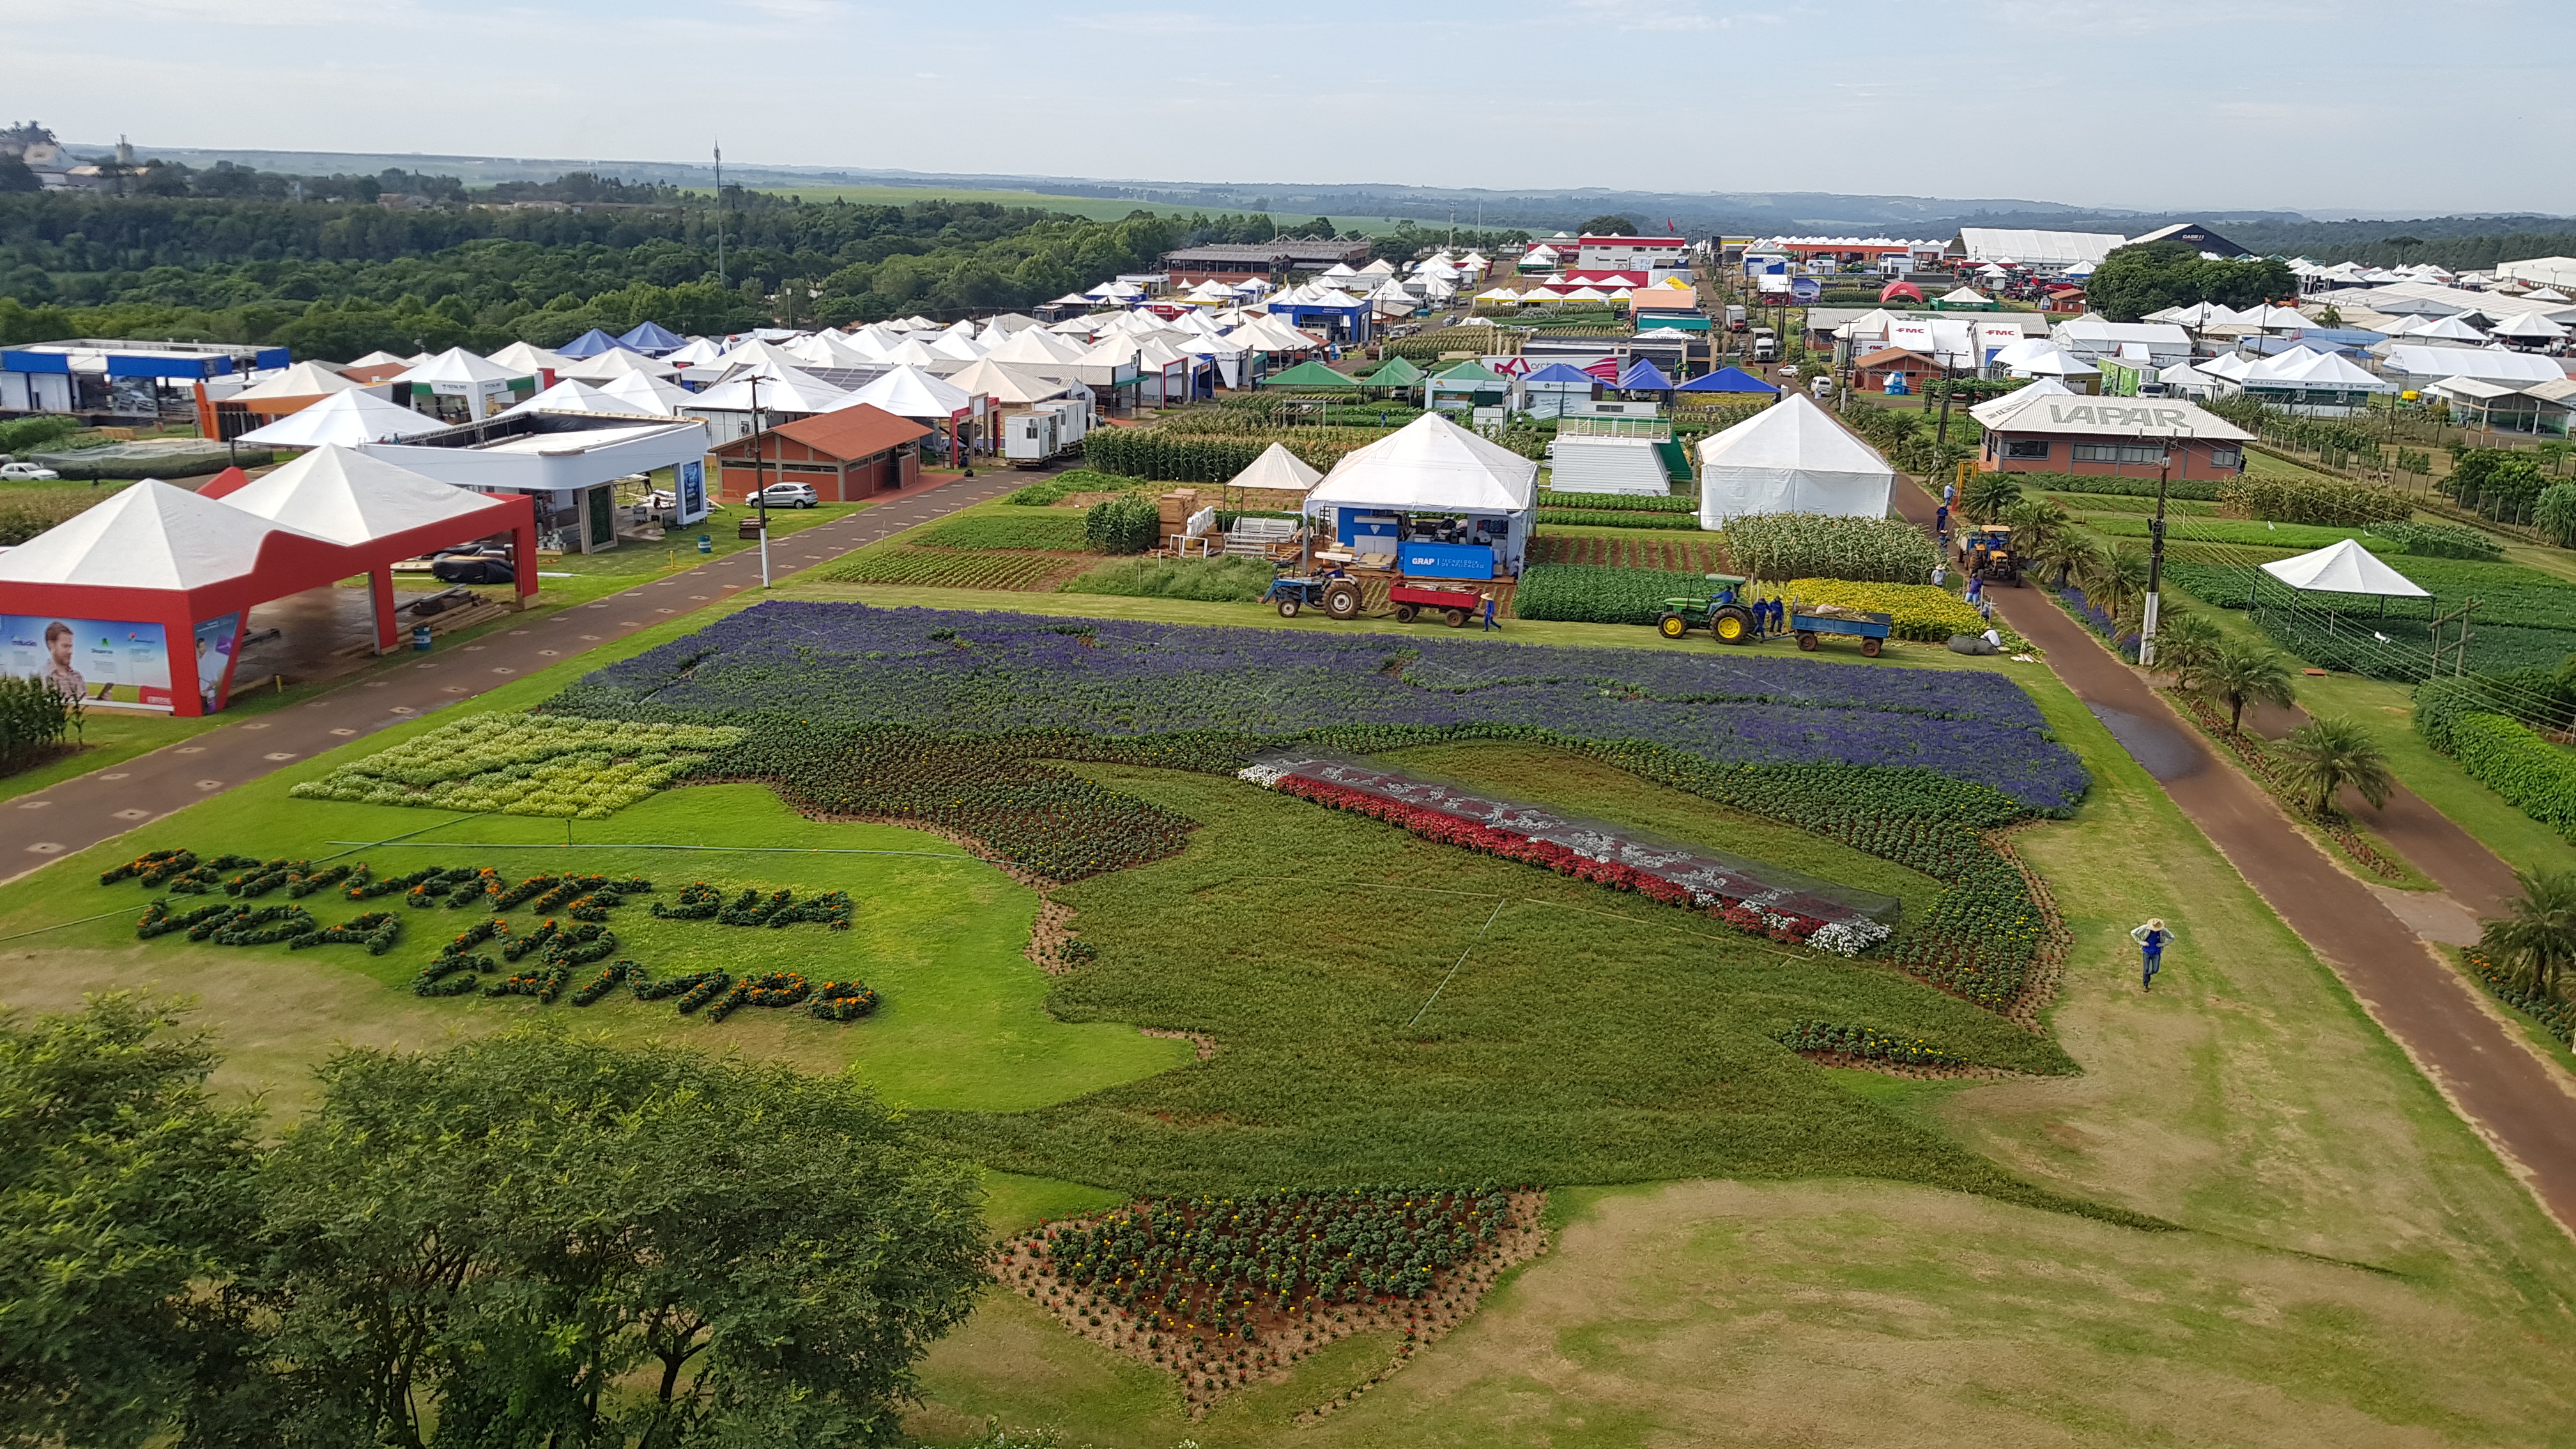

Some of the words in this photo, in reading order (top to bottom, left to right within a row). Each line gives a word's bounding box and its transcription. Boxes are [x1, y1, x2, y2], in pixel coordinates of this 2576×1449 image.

[2050, 404, 2194, 429] IAPAR
[1411, 557, 1435, 565] GRAP
[136, 896, 401, 956] VIDA
[650, 880, 852, 931] SUA
[409, 955, 882, 1022] CAMPO
